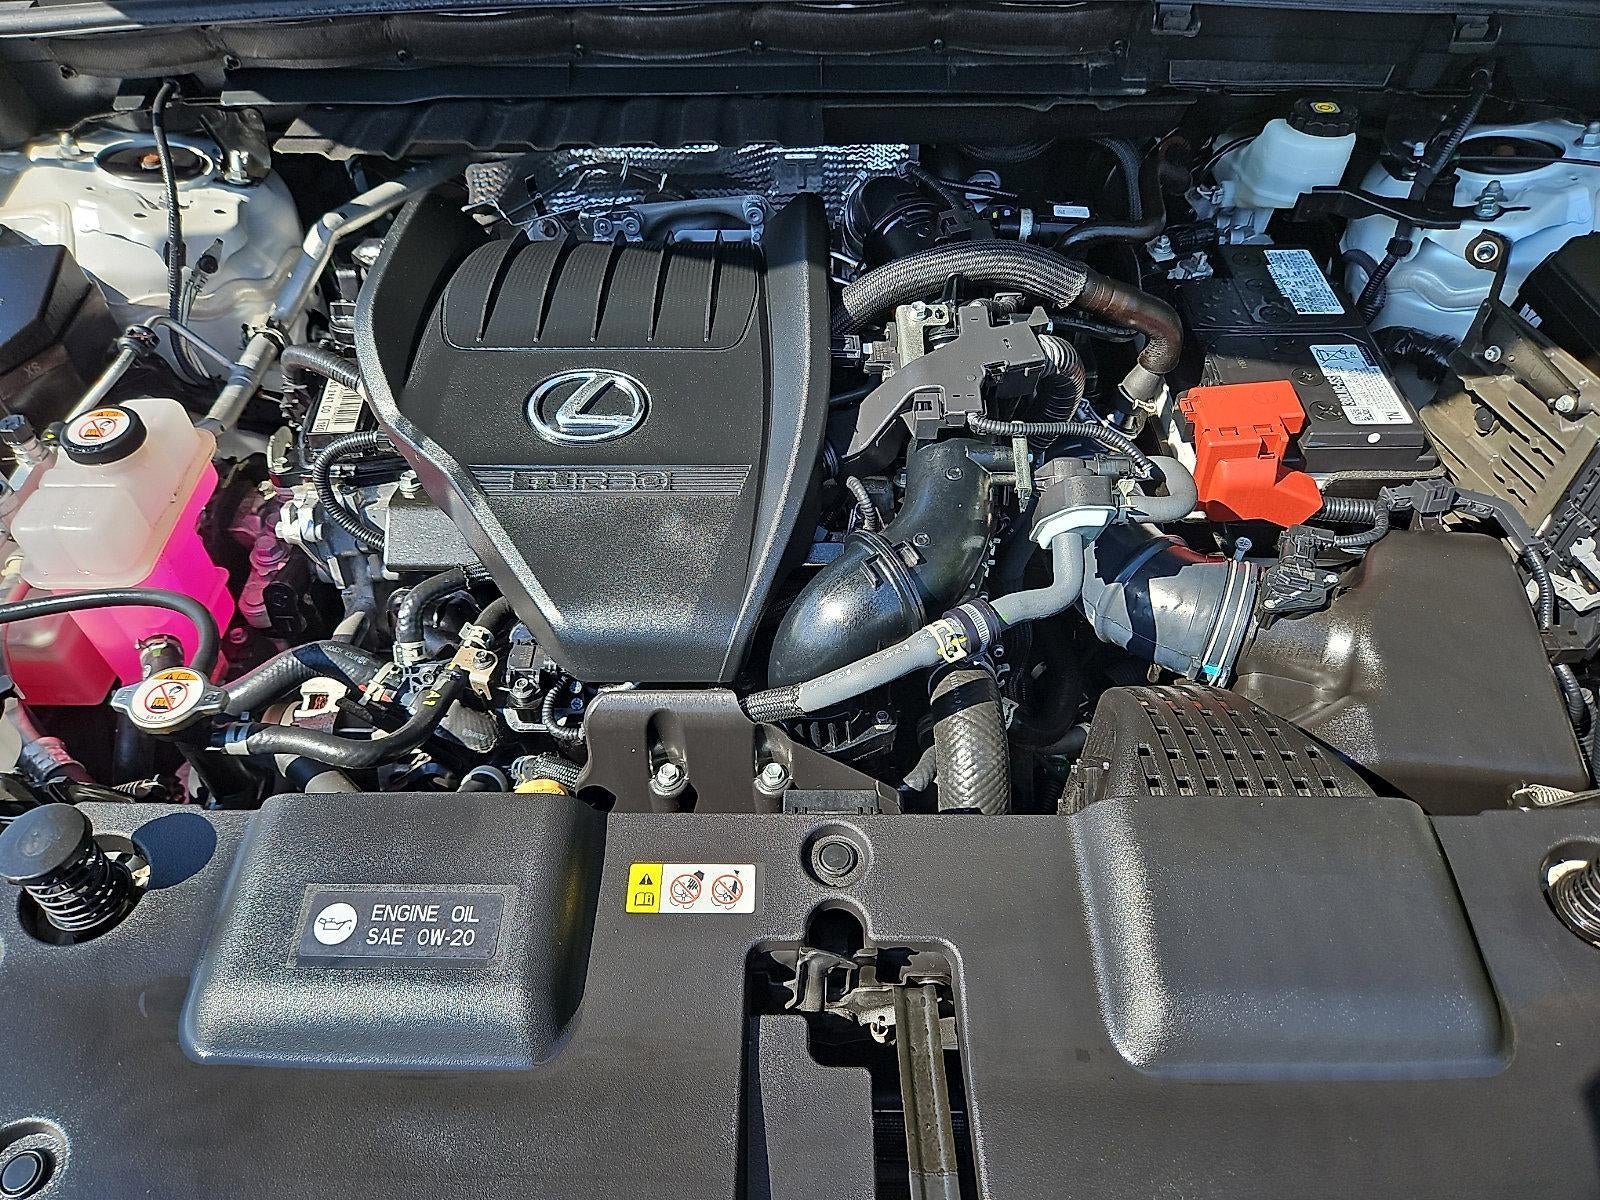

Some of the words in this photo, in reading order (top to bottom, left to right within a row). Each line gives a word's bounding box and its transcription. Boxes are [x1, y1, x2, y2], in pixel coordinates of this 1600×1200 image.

[509, 470, 668, 490] TURBO
[370, 904, 440, 922] ENGINE
[451, 905, 480, 923] OIL
[366, 927, 406, 946] SAE
[417, 928, 476, 947] 0W-20
